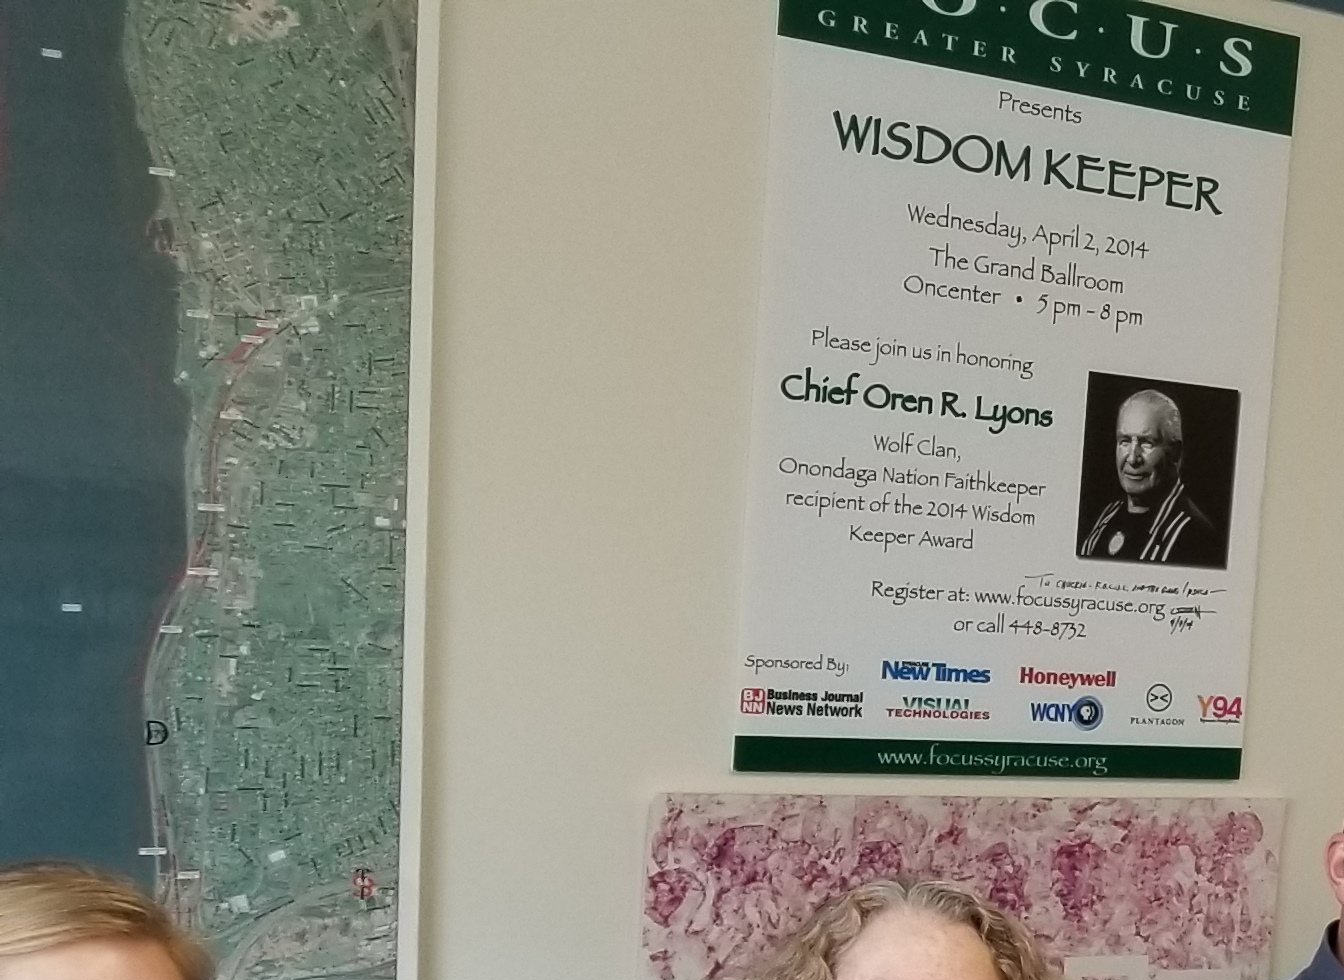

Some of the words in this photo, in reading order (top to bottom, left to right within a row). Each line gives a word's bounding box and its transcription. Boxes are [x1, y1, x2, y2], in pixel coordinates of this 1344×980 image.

[817, 8, 1018, 65] GREATER
[1049, 56, 1252, 112] SYRACUSE
[998, 91, 1083, 124] Presents
[833, 110, 1031, 182] WISDOM
[1043, 148, 1223, 216] KEEPER
[907, 203, 1028, 247] Wednesday,
[1031, 224, 1080, 255] April
[1083, 232, 1099, 255] 2,
[1105, 235, 1149, 260] 2014
[929, 246, 969, 271] The
[974, 257, 1035, 282] Grand
[1041, 264, 1124, 294] Ballroom
[903, 275, 1001, 306] Oncenter
[1035, 293, 1048, 315] 5
[1052, 301, 1082, 325] pm
[1099, 302, 1111, 322] 8
[1115, 309, 1143, 332] pm
[811, 329, 871, 353] Please
[869, 335, 907, 365] join
[912, 345, 932, 361] us
[936, 344, 952, 363] in
[955, 343, 1034, 378] honoring
[780, 368, 861, 406] Chief
[863, 383, 933, 416] Oren
[940, 391, 967, 419] R.
[974, 396, 1054, 434] Lyons
[873, 434, 914, 456] Wolf
[916, 437, 961, 461] Clan,
[779, 456, 878, 486] Onondaga
[882, 466, 939, 489] Nation
[944, 470, 1046, 499] Faithkeeper
[785, 489, 865, 519] recipient
[869, 491, 893, 516] of
[894, 495, 923, 516] the
[926, 500, 968, 522] 2014
[972, 502, 1035, 526] Wisdom
[848, 524, 915, 547] Keeper
[918, 530, 974, 550] Award
[871, 580, 945, 606] Register
[948, 584, 969, 604] at:
[974, 586, 1165, 620] www.focussyracuse.org
[953, 619, 972, 635] or
[975, 615, 1005, 635] call
[1008, 618, 1087, 639] 448-8732
[744, 654, 823, 675] Sponsored
[881, 660, 932, 681] New
[932, 663, 990, 683] Times
[1020, 667, 1116, 689] Honeywell
[766, 702, 803, 716] News
[807, 703, 863, 718] Network
[767, 689, 818, 701] Business
[821, 691, 863, 703] Journal
[1031, 702, 1074, 722] WCNY
[1198, 695, 1242, 719] Y94
[886, 708, 990, 720] TECHNOLOGIES
[878, 743, 1108, 776] www.focussyracuse.org
